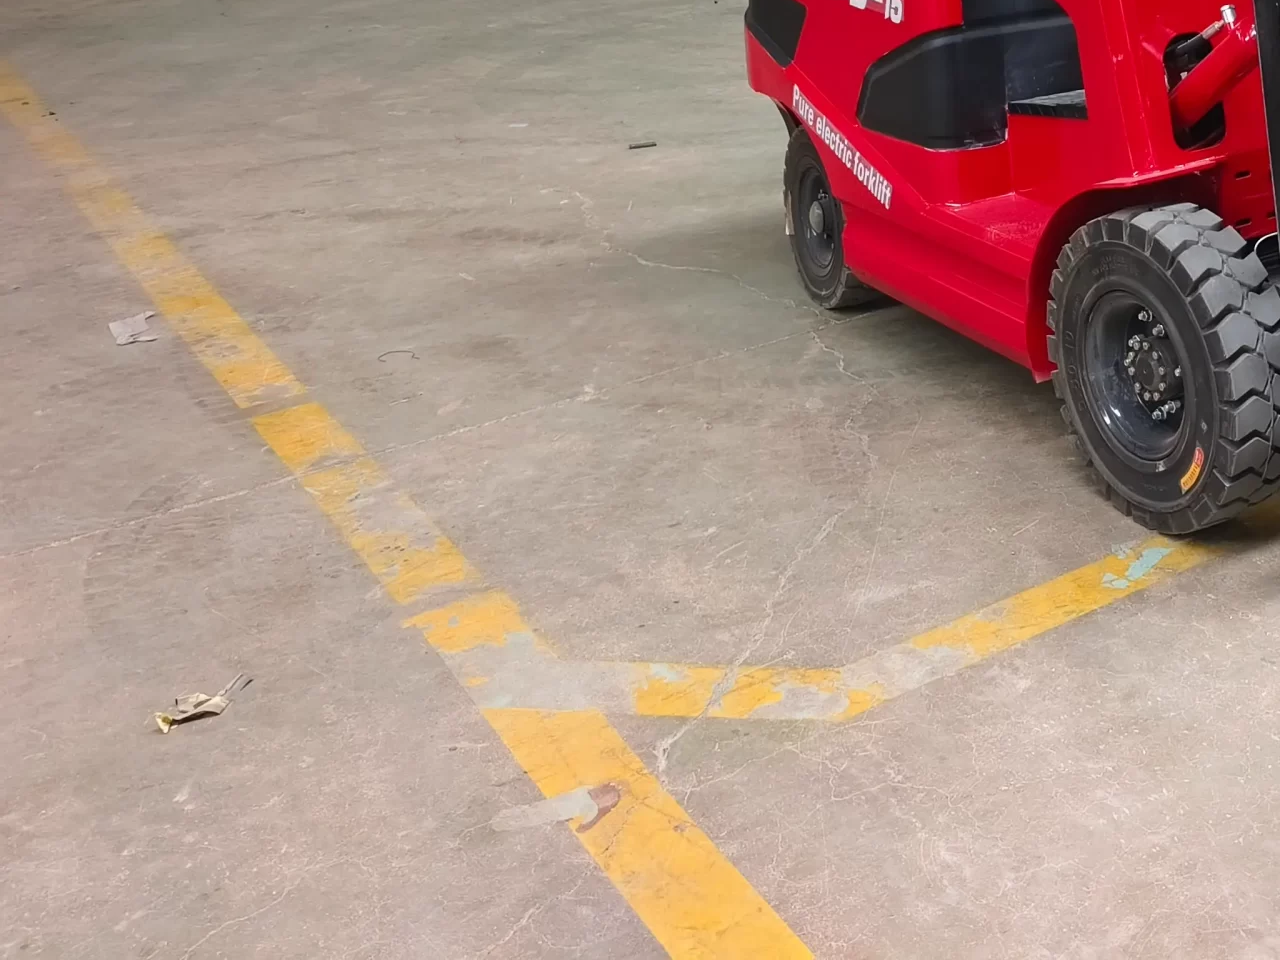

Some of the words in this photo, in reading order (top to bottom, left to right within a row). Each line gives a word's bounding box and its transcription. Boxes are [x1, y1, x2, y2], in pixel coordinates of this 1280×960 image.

[792, 83, 814, 127] Pure
[816, 115, 852, 170] electric
[853, 151, 892, 211] forklift
